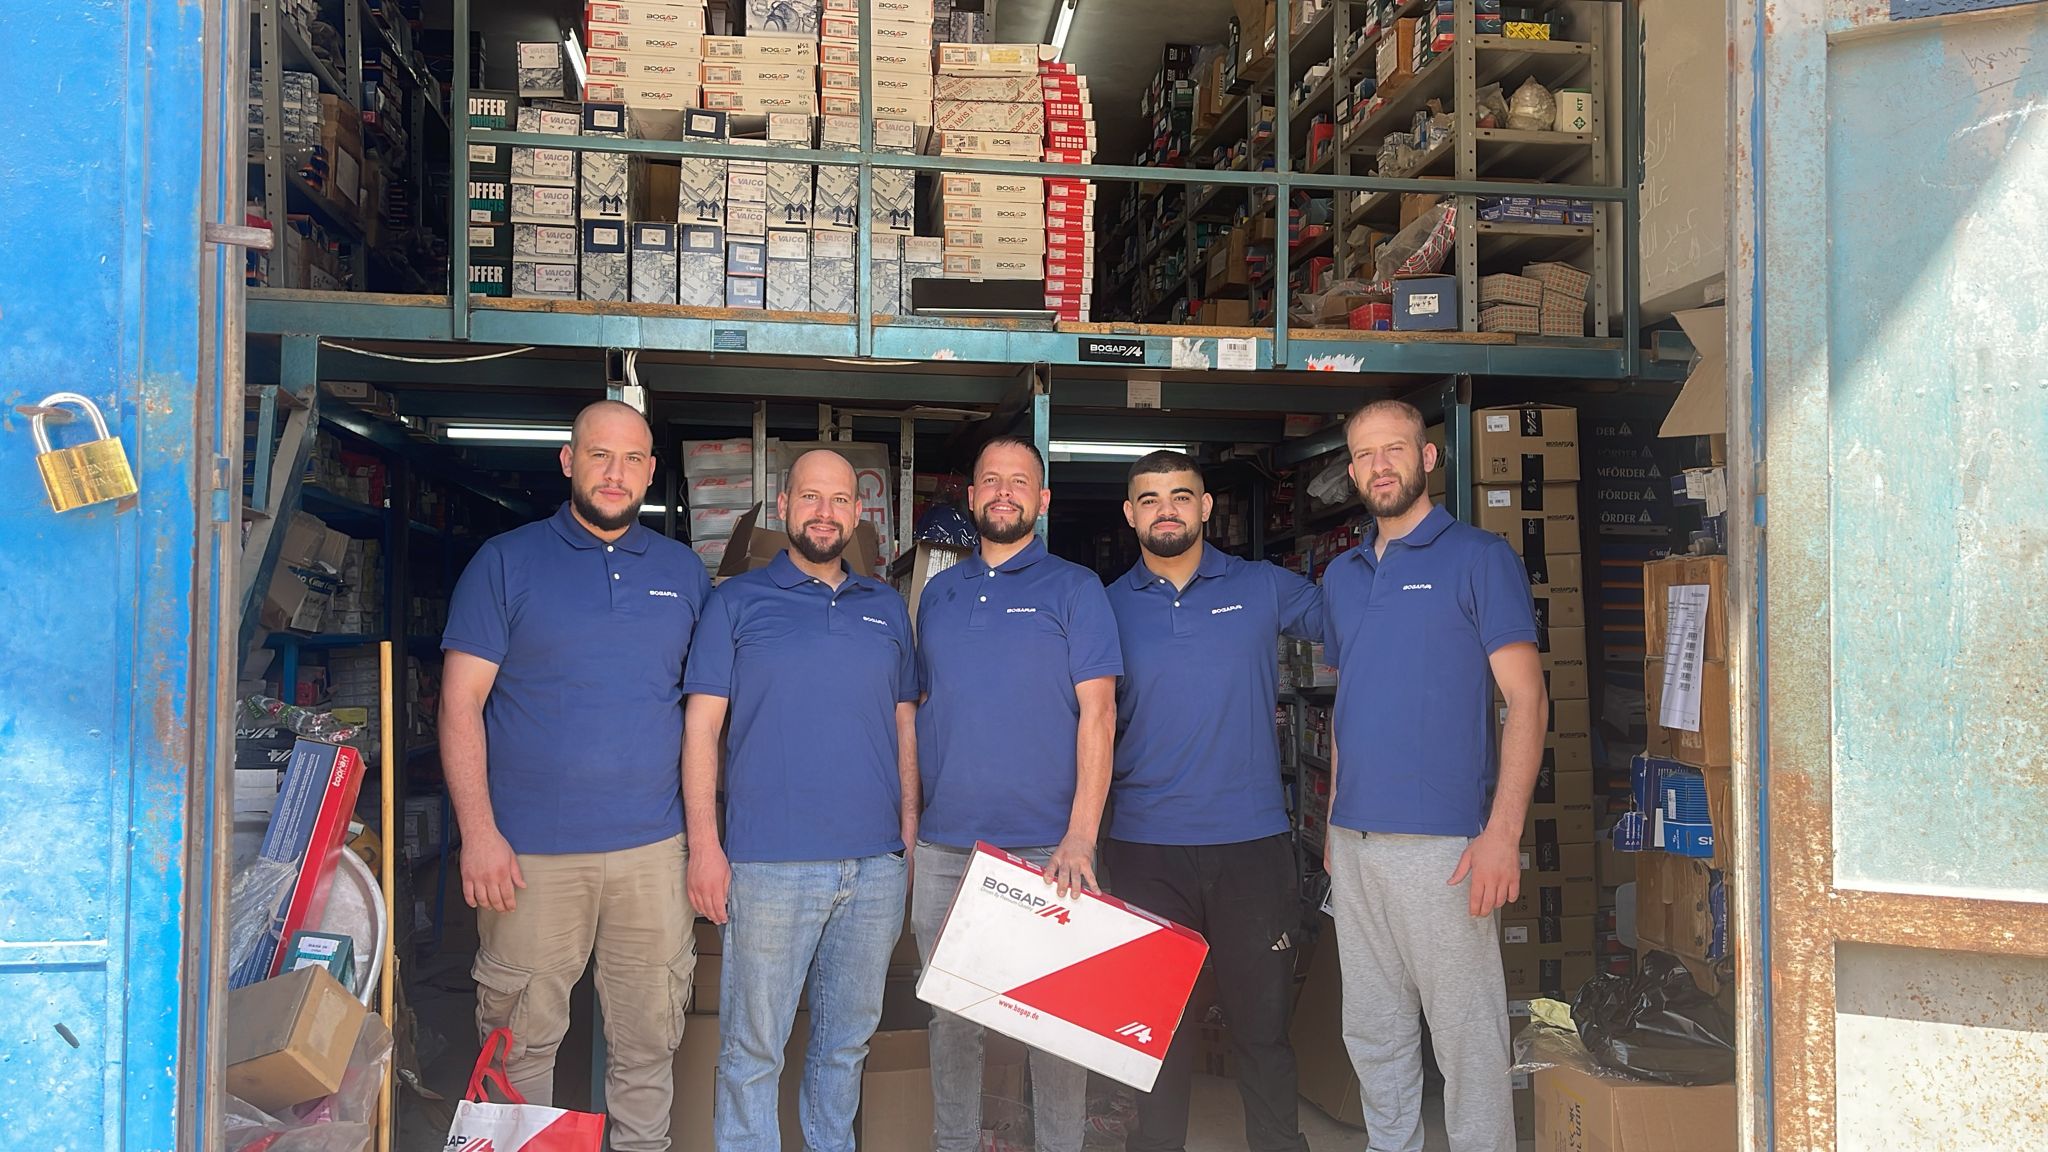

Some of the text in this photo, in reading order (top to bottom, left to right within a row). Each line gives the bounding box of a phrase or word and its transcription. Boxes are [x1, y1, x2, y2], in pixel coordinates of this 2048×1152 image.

[550, 116, 577, 125] VAICO
[543, 154, 569, 162] VAICO
[737, 178, 763, 186] VAICO
[737, 212, 762, 220] VAICO
[778, 235, 804, 243] VAICO
[822, 234, 848, 242] VAICO
[913, 238, 937, 247] VAICO
[1598, 488, 1640, 500] FÖRDER
[332, 755, 350, 787] topran
[983, 876, 1046, 907] BOGAP
[999, 999, 1039, 1021] www.bogap.de
